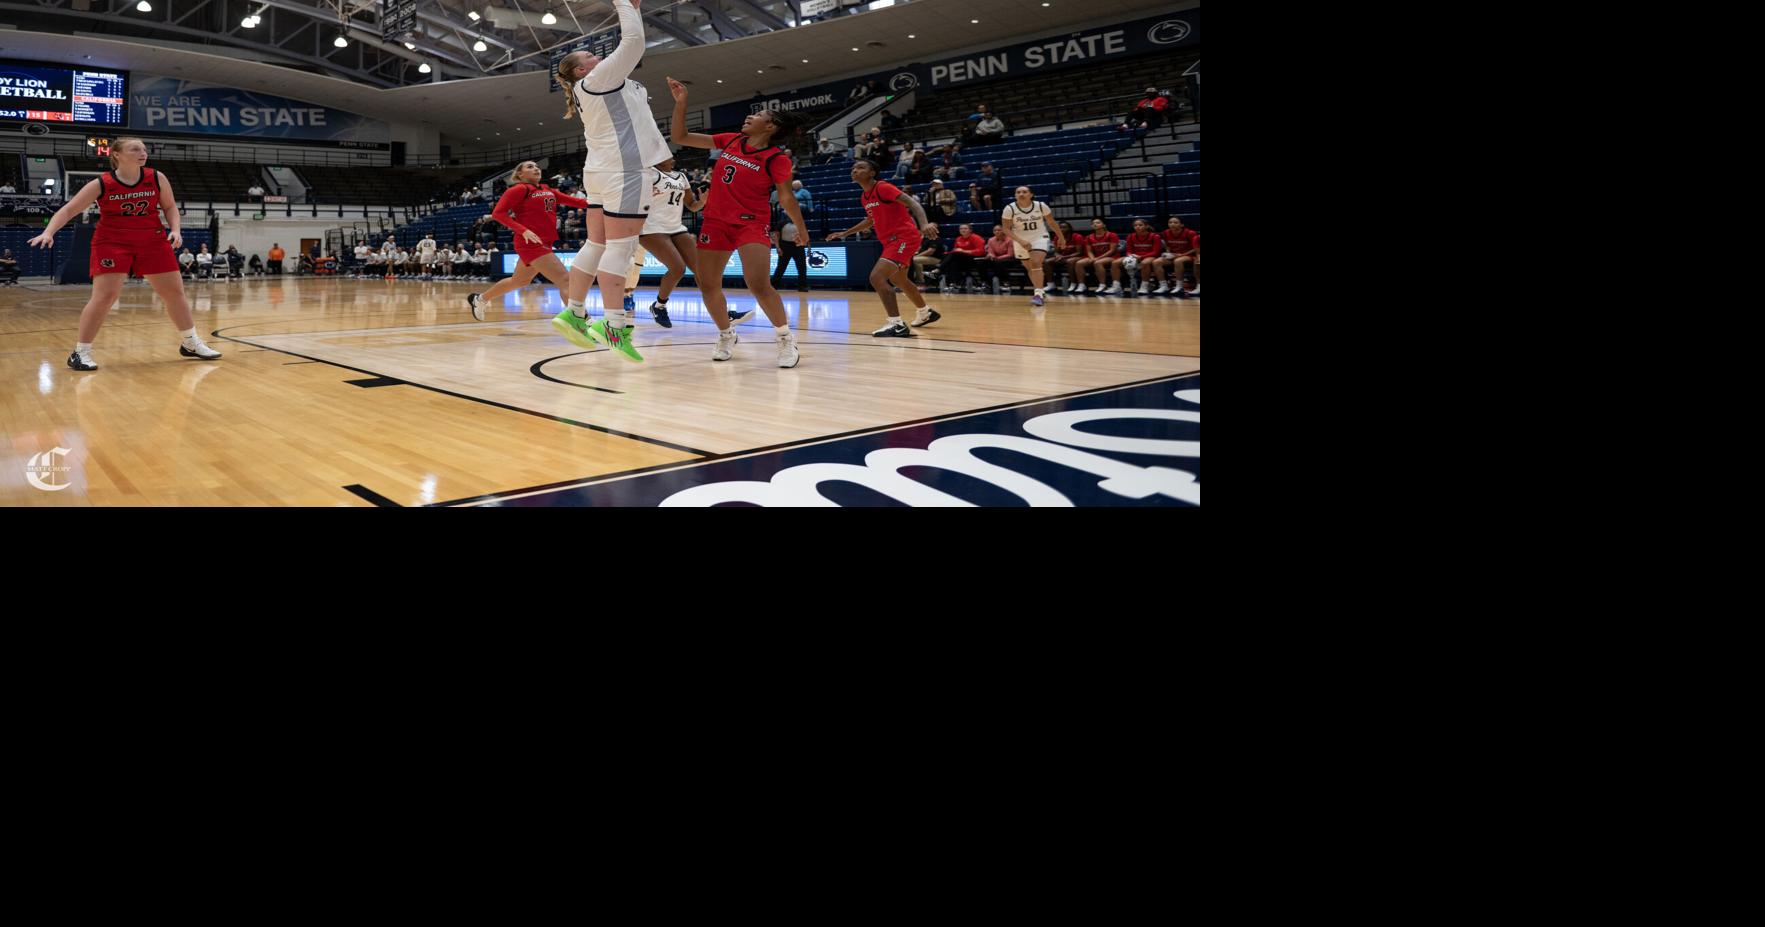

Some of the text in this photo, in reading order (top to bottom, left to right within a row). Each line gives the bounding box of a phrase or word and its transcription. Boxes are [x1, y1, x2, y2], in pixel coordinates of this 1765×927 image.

[931, 30, 1127, 86] PENN STATE
[15, 78, 48, 88] LION
[0, 86, 67, 100] ETBALL
[135, 95, 201, 107] WE ARE
[781, 94, 833, 112] NETWORK
[146, 107, 327, 127] PENN STATE
[97, 146, 110, 157] 14
[721, 152, 761, 172] CALIFORNIA
[722, 164, 737, 185] 3
[109, 190, 155, 201] CALIFORNIA
[667, 191, 683, 206] 14
[120, 200, 149, 217] 22
[1023, 221, 1038, 231] 10
